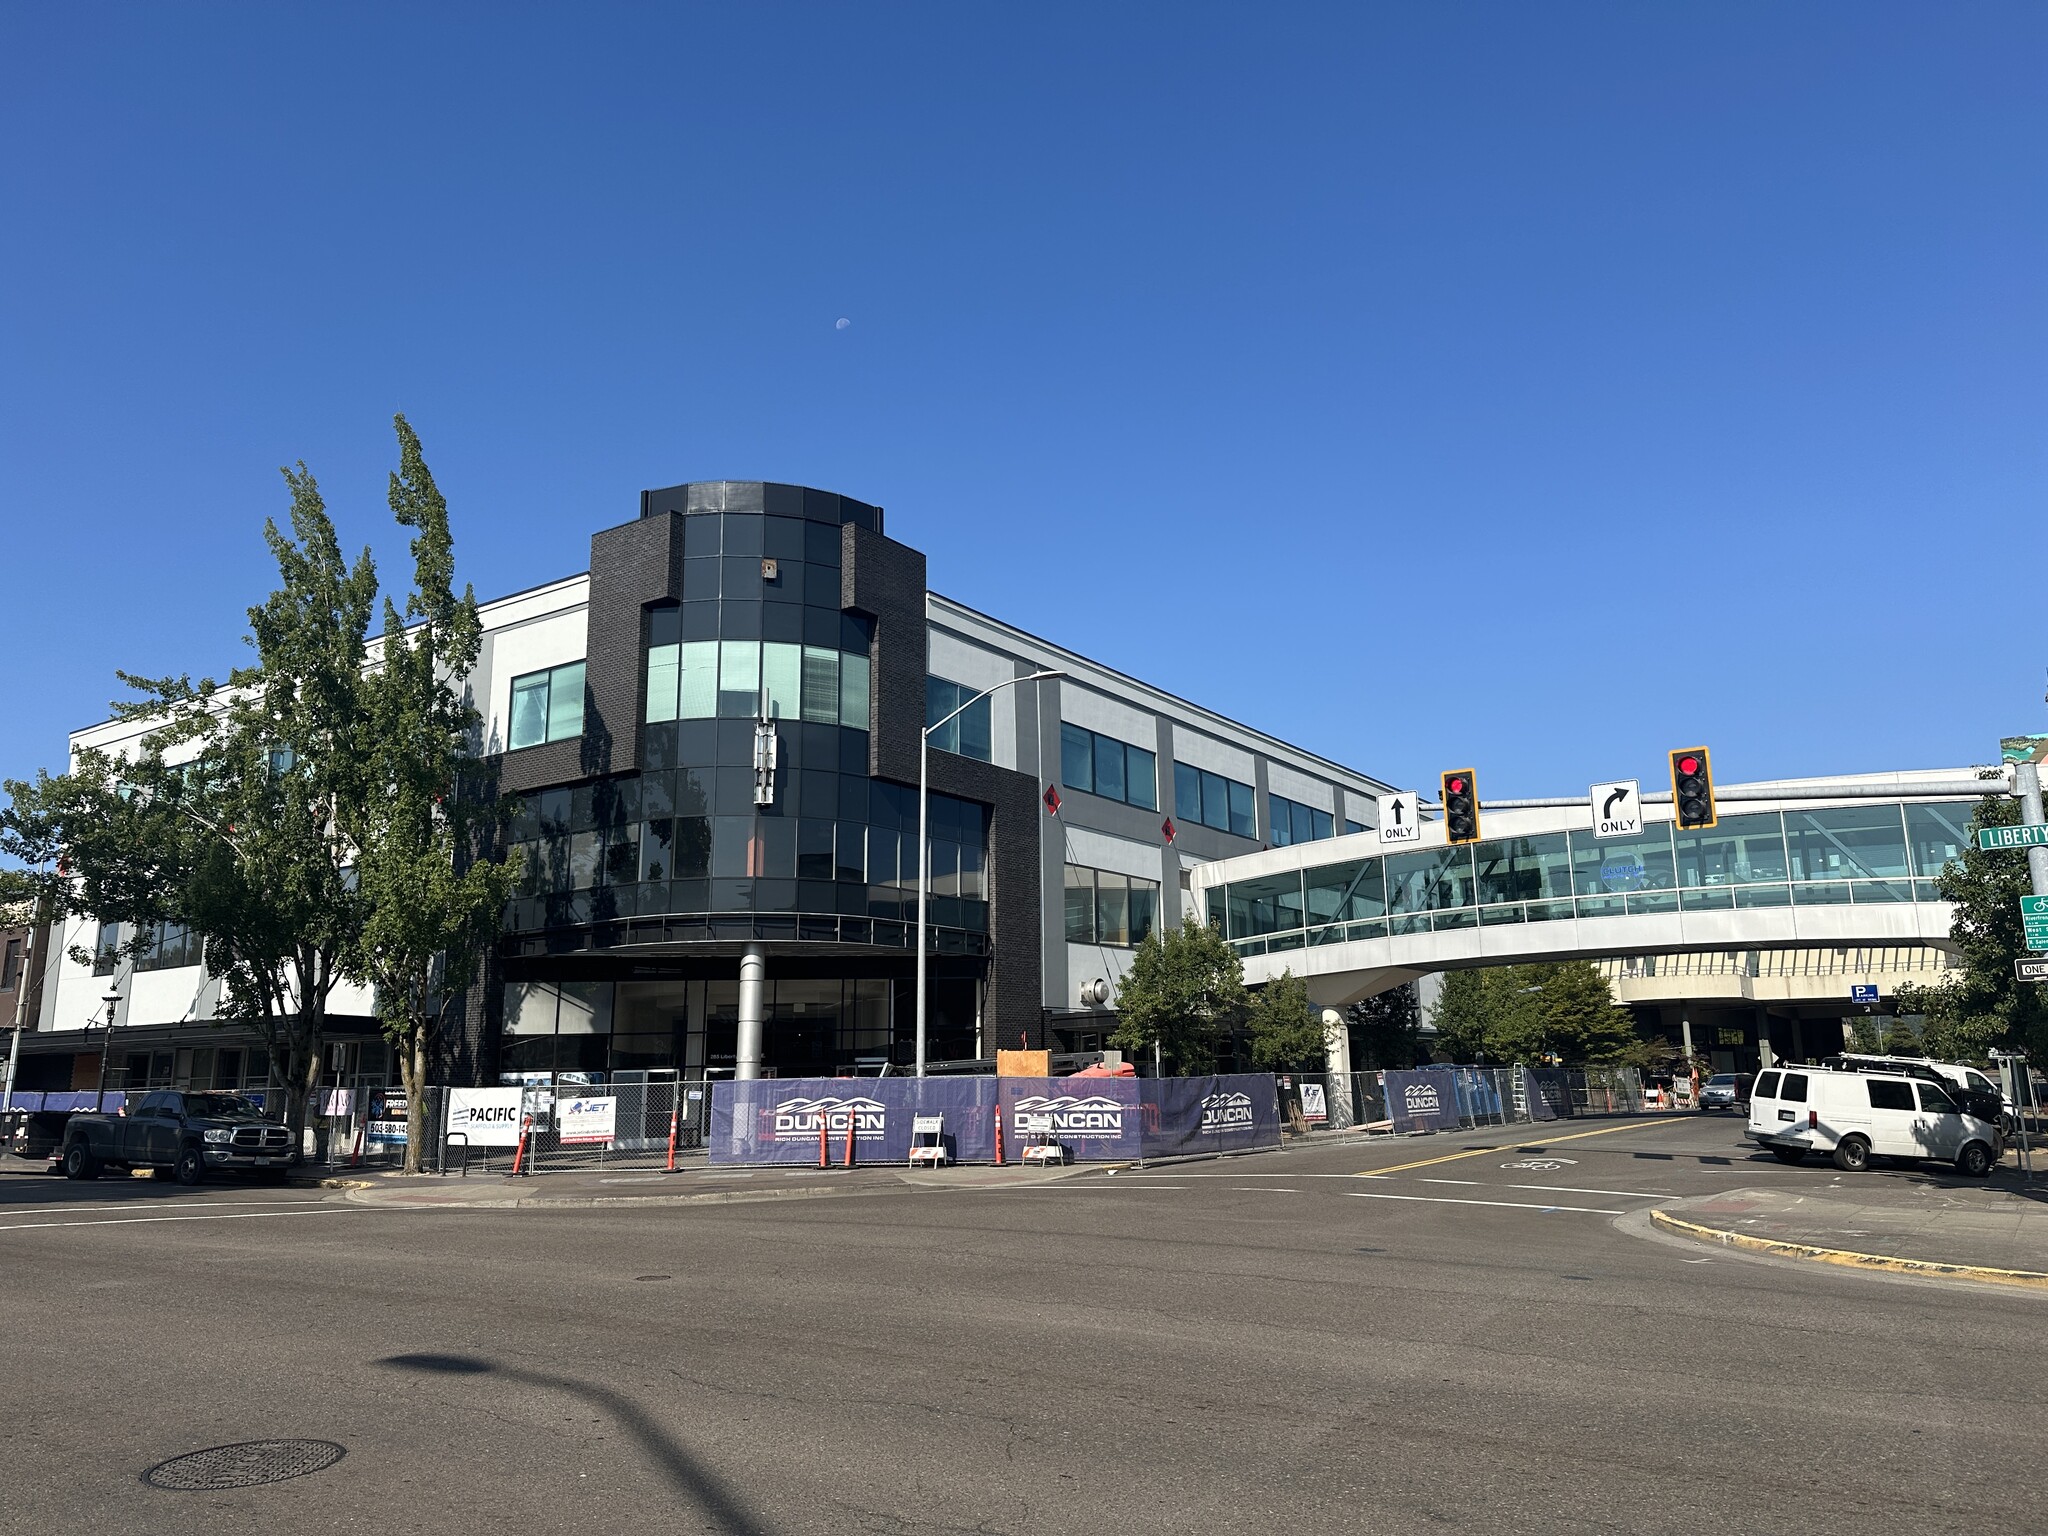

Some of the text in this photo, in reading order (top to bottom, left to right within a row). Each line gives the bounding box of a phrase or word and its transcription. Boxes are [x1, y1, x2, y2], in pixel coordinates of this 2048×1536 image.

[1385, 827, 1412, 838] ONLY
[1601, 820, 1635, 833] ONLY
[1989, 826, 2048, 846] LIBERTY
[1602, 865, 1642, 875] CLUTCH
[2025, 965, 2046, 974] ONE
[585, 1103, 609, 1112] JET
[1406, 1097, 1439, 1109] DUNCAN
[470, 1107, 516, 1122] PACIFIC
[1014, 1113, 1121, 1128] DNCAN
[1202, 1107, 1253, 1124] DUNCAN
